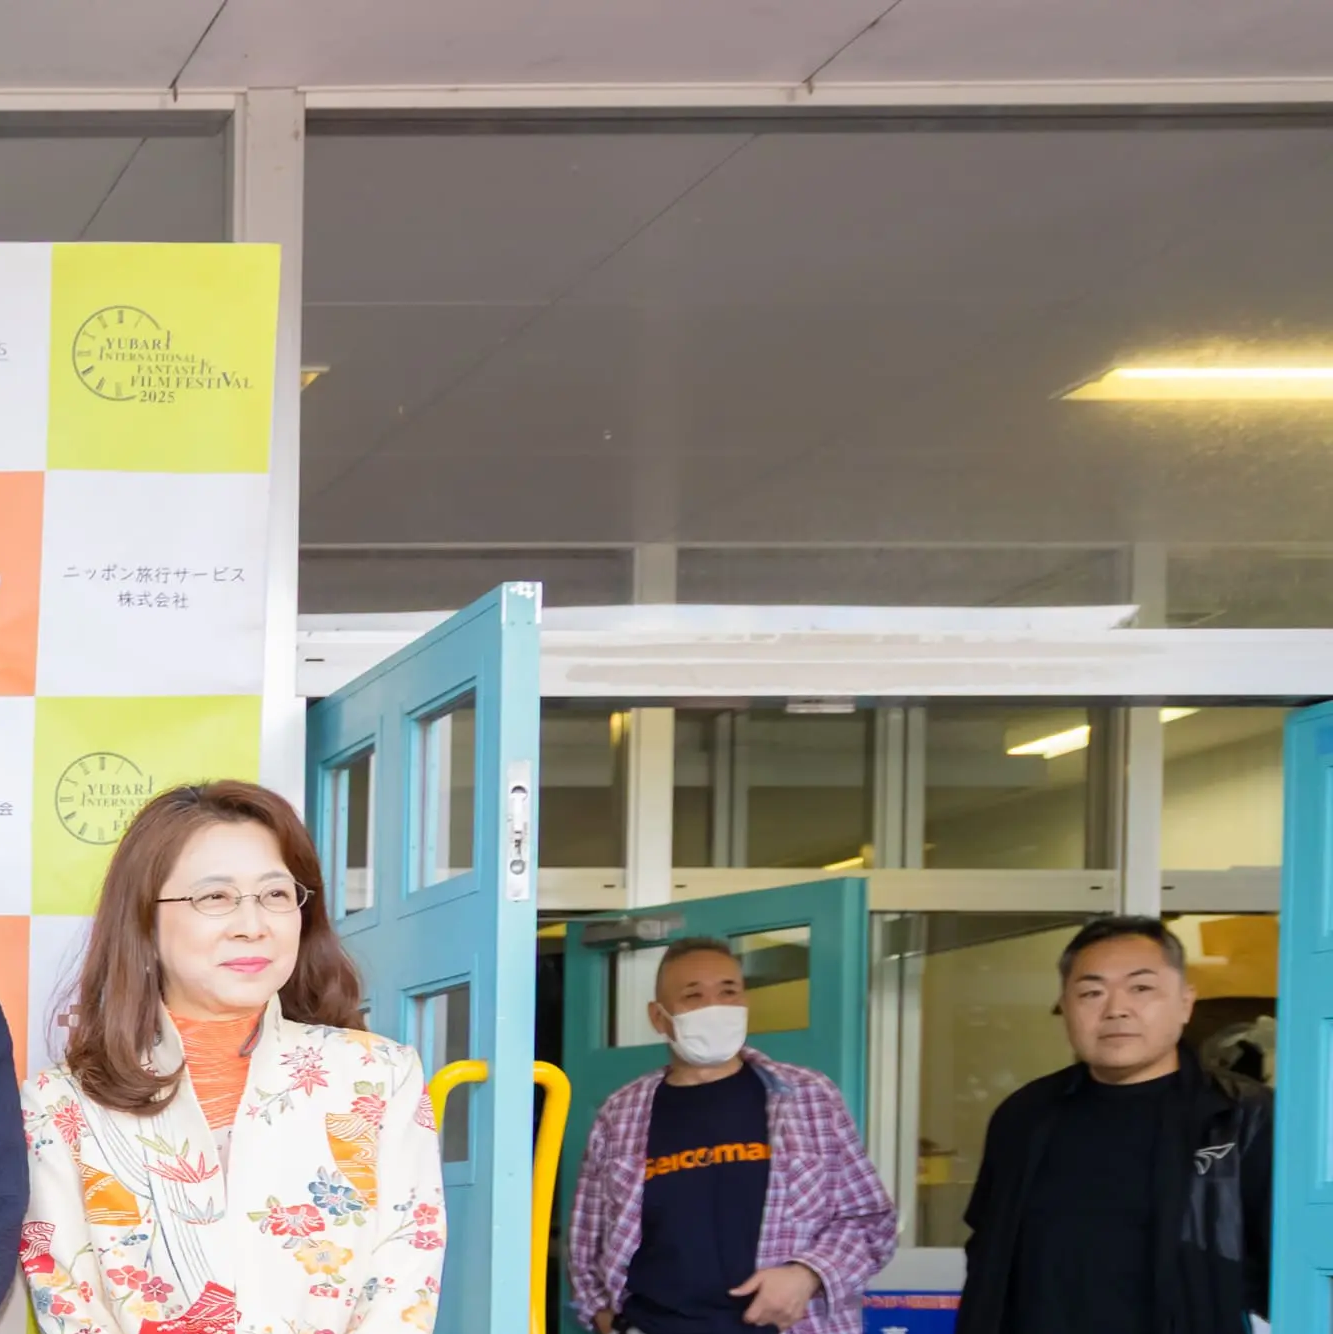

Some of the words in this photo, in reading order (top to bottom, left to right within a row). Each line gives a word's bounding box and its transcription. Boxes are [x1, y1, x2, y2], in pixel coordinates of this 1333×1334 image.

[106, 330, 171, 350] YUBARI
[99, 347, 197, 363] INTERNATIONAL
[130, 376, 171, 388] FILM
[176, 372, 254, 390] FESTIVAL
[139, 390, 176, 403] 2025
[117, 590, 190, 609] 株式会社
